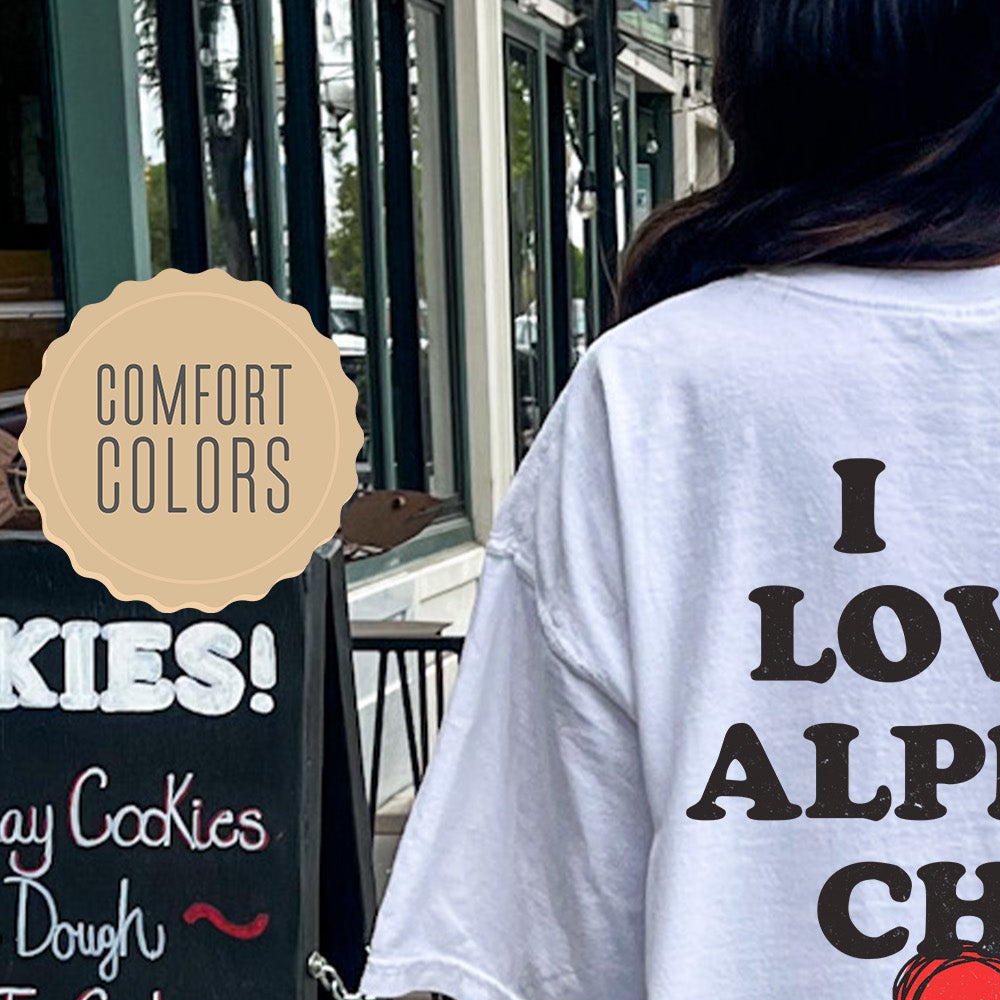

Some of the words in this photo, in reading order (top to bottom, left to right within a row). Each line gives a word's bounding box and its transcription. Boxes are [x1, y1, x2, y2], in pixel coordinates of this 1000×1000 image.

[832, 457, 887, 554] I
[0, 617, 277, 716] KIES!
[3, 877, 166, 981] Dough
